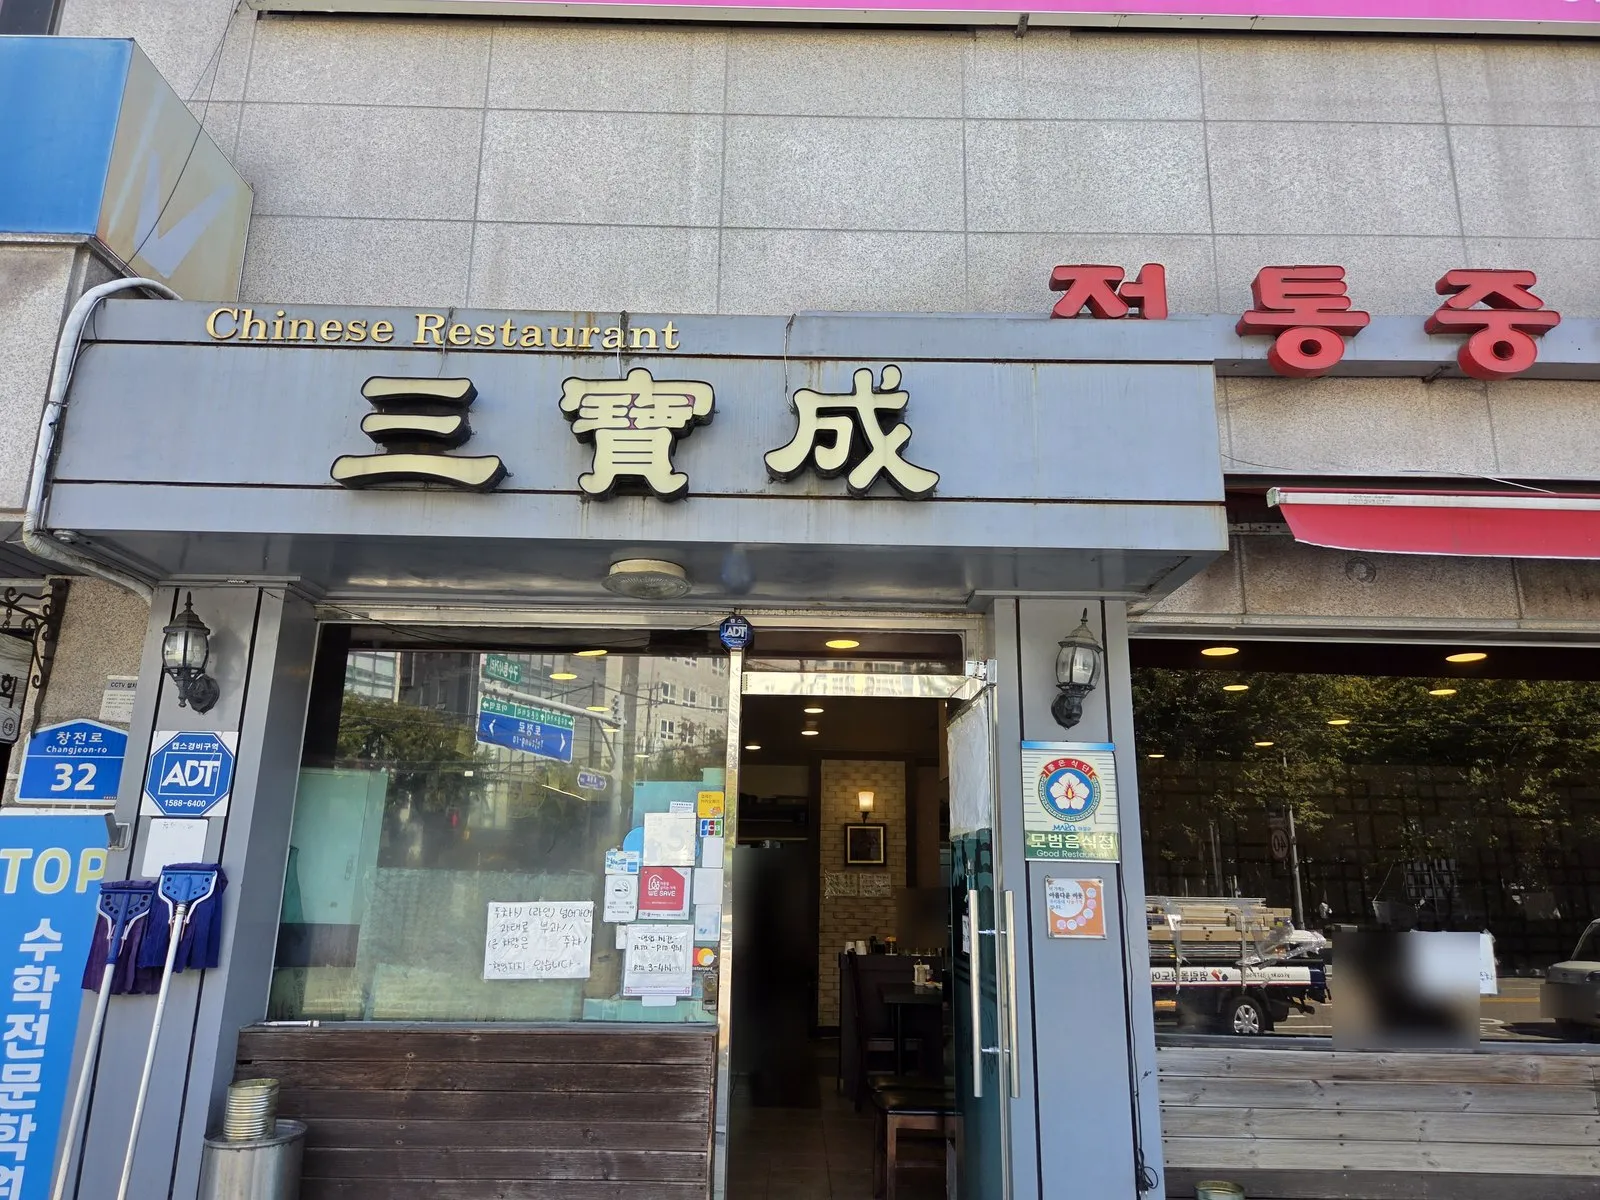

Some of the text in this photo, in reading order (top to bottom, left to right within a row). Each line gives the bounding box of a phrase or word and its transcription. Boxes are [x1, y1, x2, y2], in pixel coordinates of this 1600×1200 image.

[204, 307, 680, 350] Chinese Restaurant
[726, 626, 747, 638] ADT
[56, 731, 104, 745] 창전로
[46, 745, 108, 755] Changjeon-ro
[171, 742, 219, 751] 캡스경비구역
[50, 762, 97, 792] 32
[161, 759, 221, 787] ADT
[164, 799, 206, 808] 1588-6400
[1030, 833, 1114, 849] 모범음식점
[1036, 850, 1060, 858] Good
[0, 847, 108, 894] TOP
